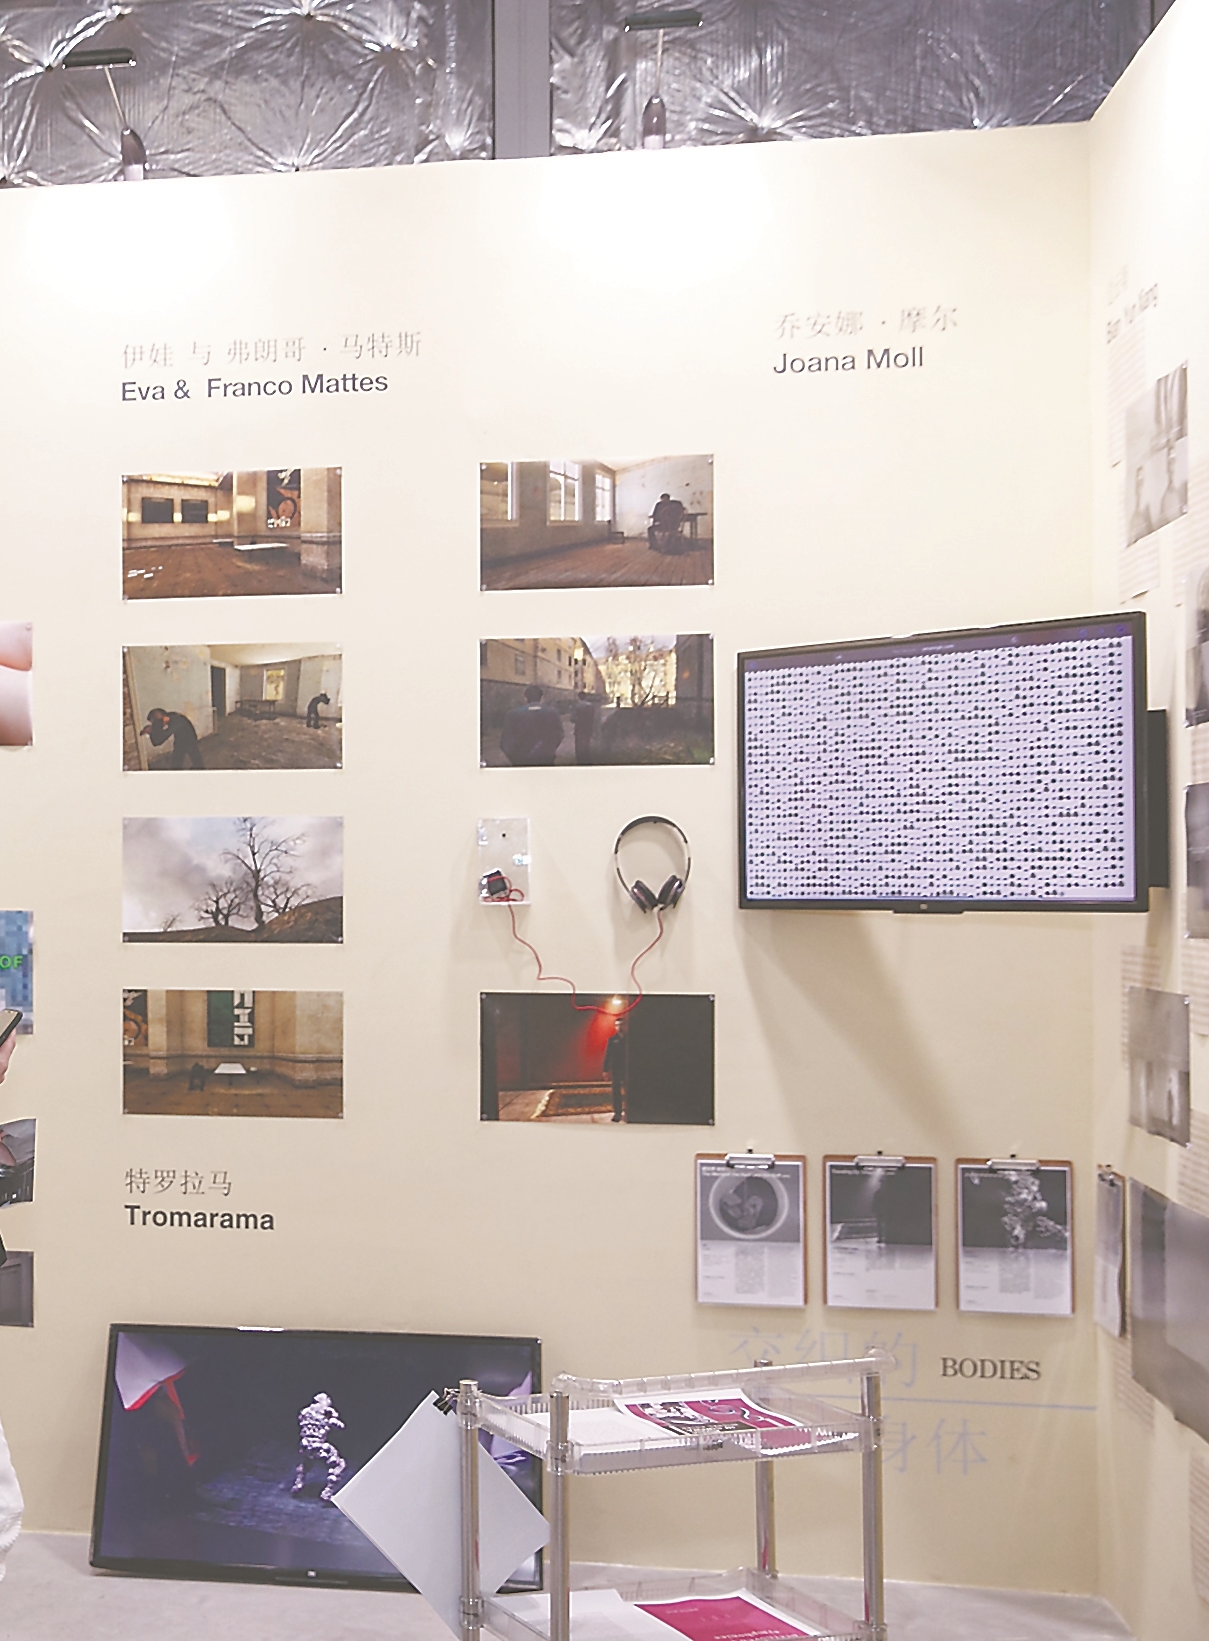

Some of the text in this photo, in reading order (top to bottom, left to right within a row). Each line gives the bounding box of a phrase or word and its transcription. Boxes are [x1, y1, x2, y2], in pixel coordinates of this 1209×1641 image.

[773, 346, 924, 374] Joana Moll
[121, 373, 389, 402] Eva & Franco Mattes
[125, 1167, 233, 1197] 特罗拉马
[124, 1204, 276, 1231] Tromarama
[940, 1356, 1042, 1381] BODIES
